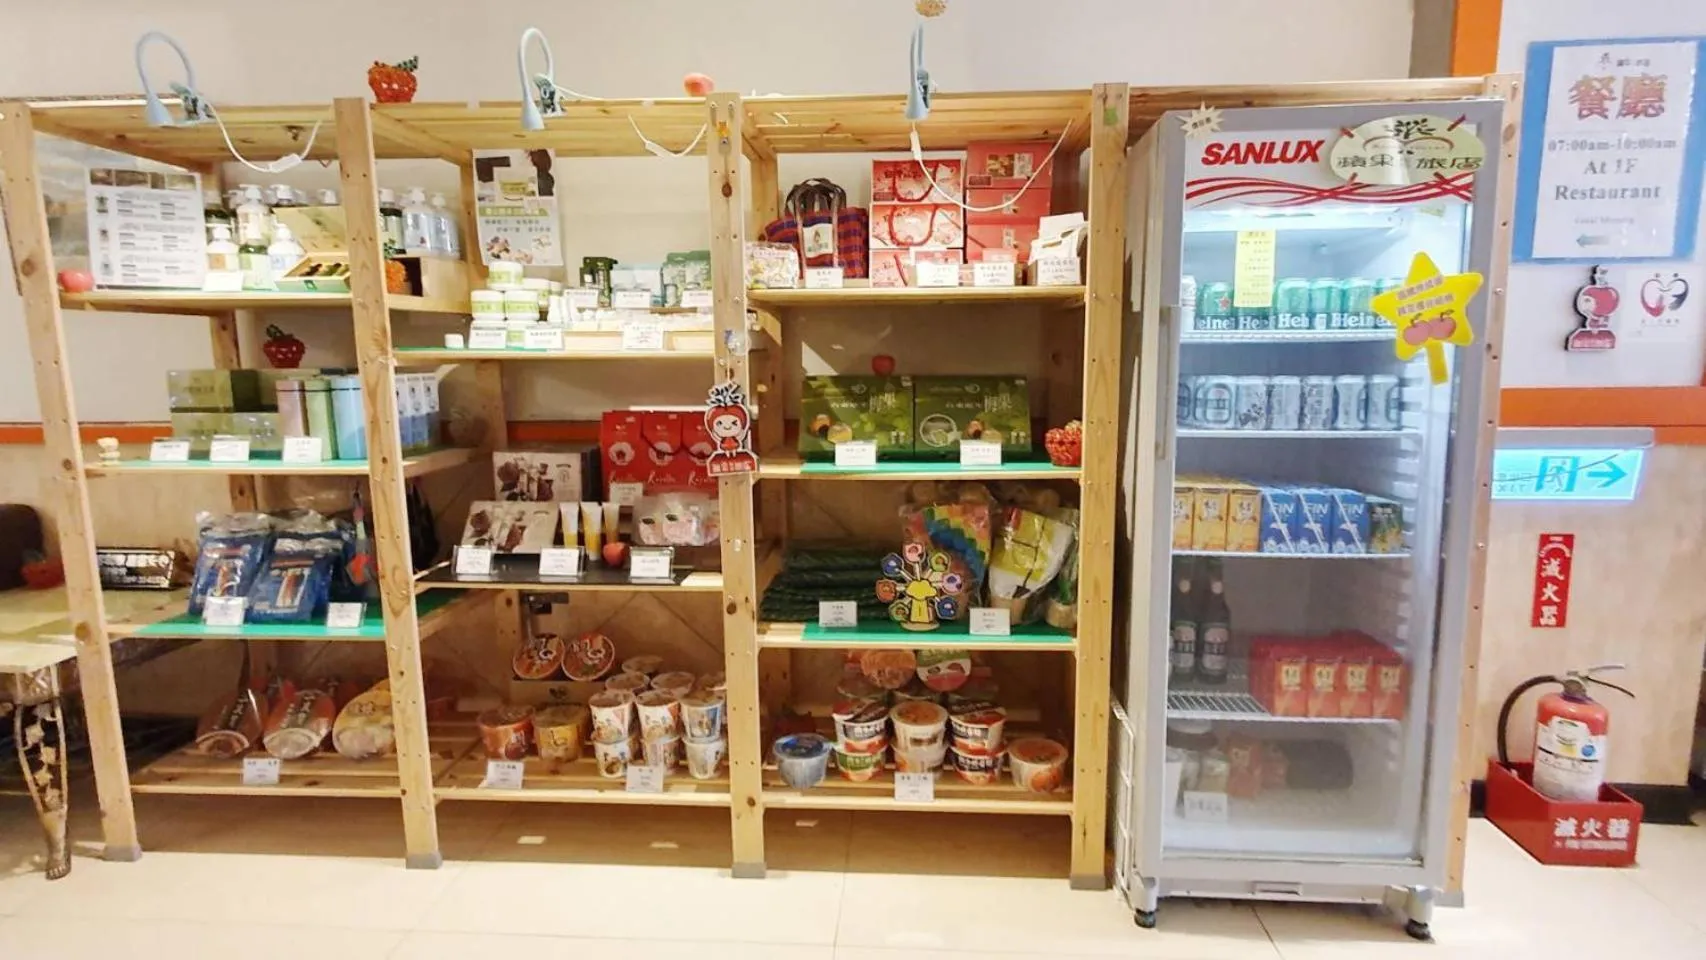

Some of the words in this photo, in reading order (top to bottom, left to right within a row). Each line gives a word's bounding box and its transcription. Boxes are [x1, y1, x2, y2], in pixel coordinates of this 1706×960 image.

[1201, 140, 1325, 166] SANLUX
[1584, 159, 1608, 175] At
[1614, 157, 1639, 174] 1F
[1555, 184, 1662, 201] Restaurant
[1553, 816, 1631, 840] 滅火器
